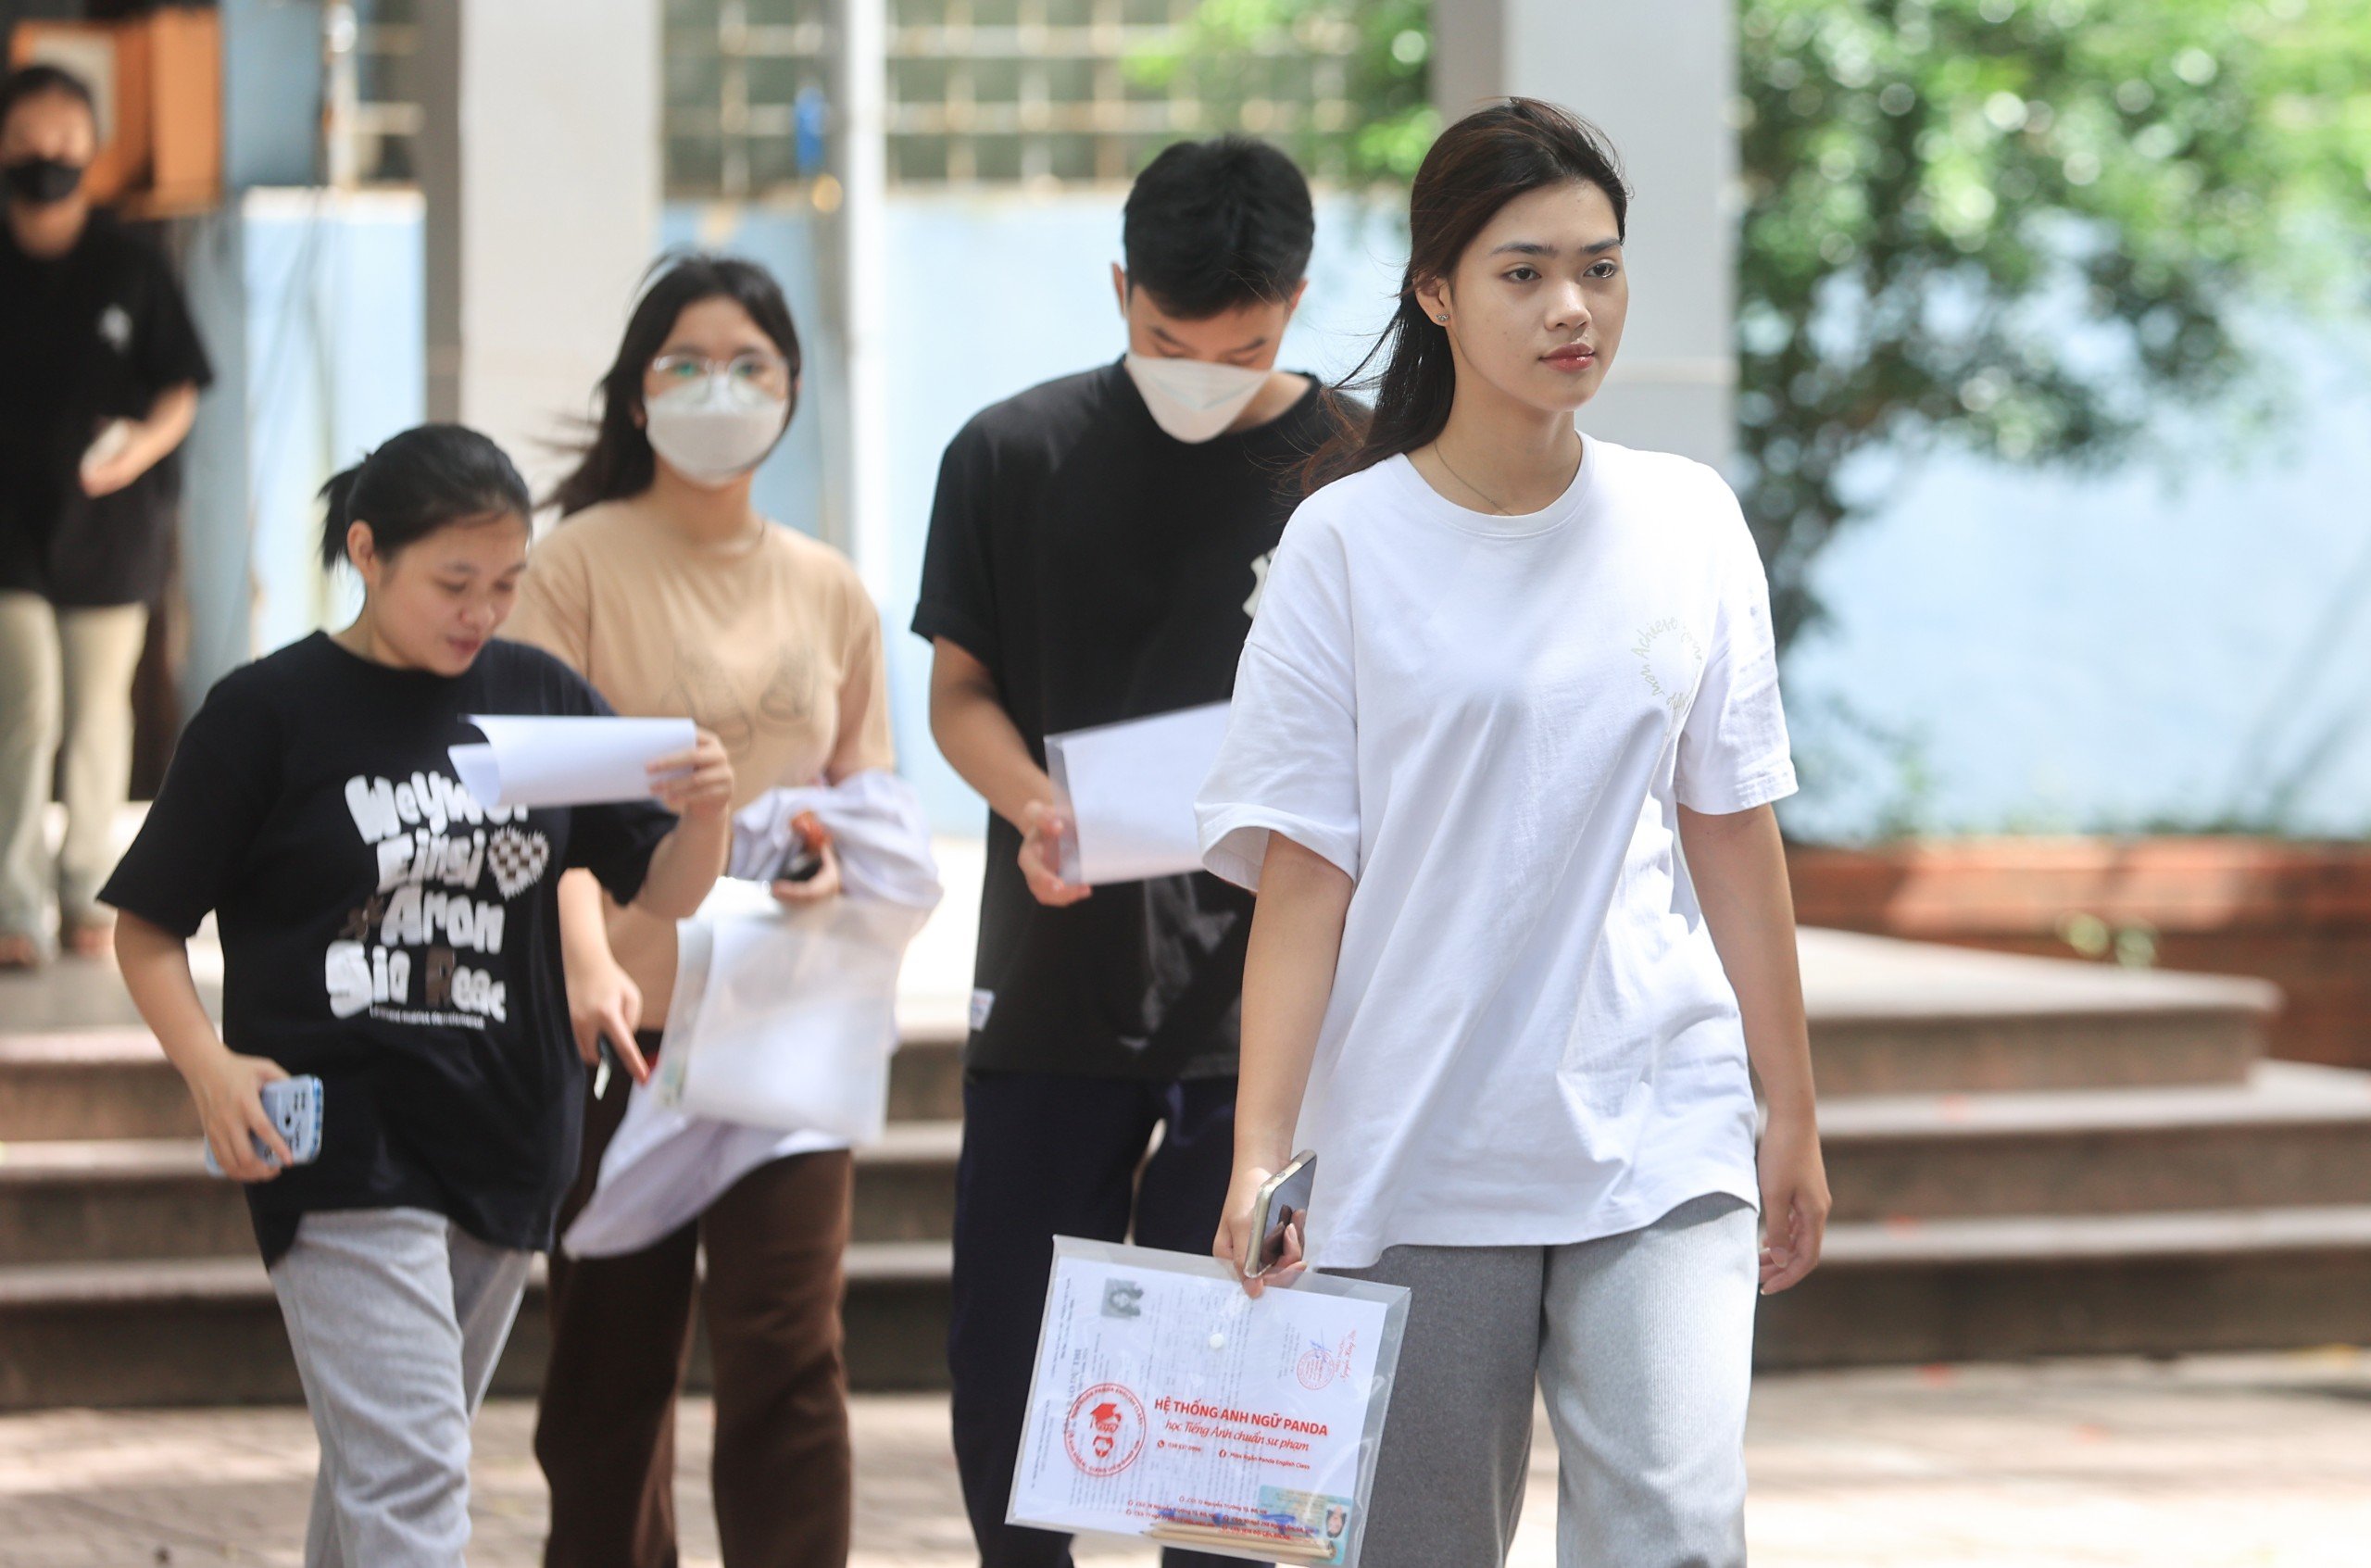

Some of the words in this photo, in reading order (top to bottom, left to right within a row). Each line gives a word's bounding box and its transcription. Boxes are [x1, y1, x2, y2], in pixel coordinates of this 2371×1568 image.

[1154, 1396, 1172, 1415] HỆ
[1173, 1399, 1218, 1419] THỐNG
[1220, 1409, 1248, 1424] ANH
[1251, 1412, 1282, 1428] NGỮ
[1284, 1419, 1328, 1436] PANDA
[1165, 1419, 1182, 1432] học
[1185, 1421, 1210, 1437] Tiếng
[1211, 1427, 1233, 1439] Anh
[1233, 1431, 1265, 1445] chuẩn
[1265, 1436, 1278, 1447] sư
[1278, 1439, 1310, 1451] phạm
